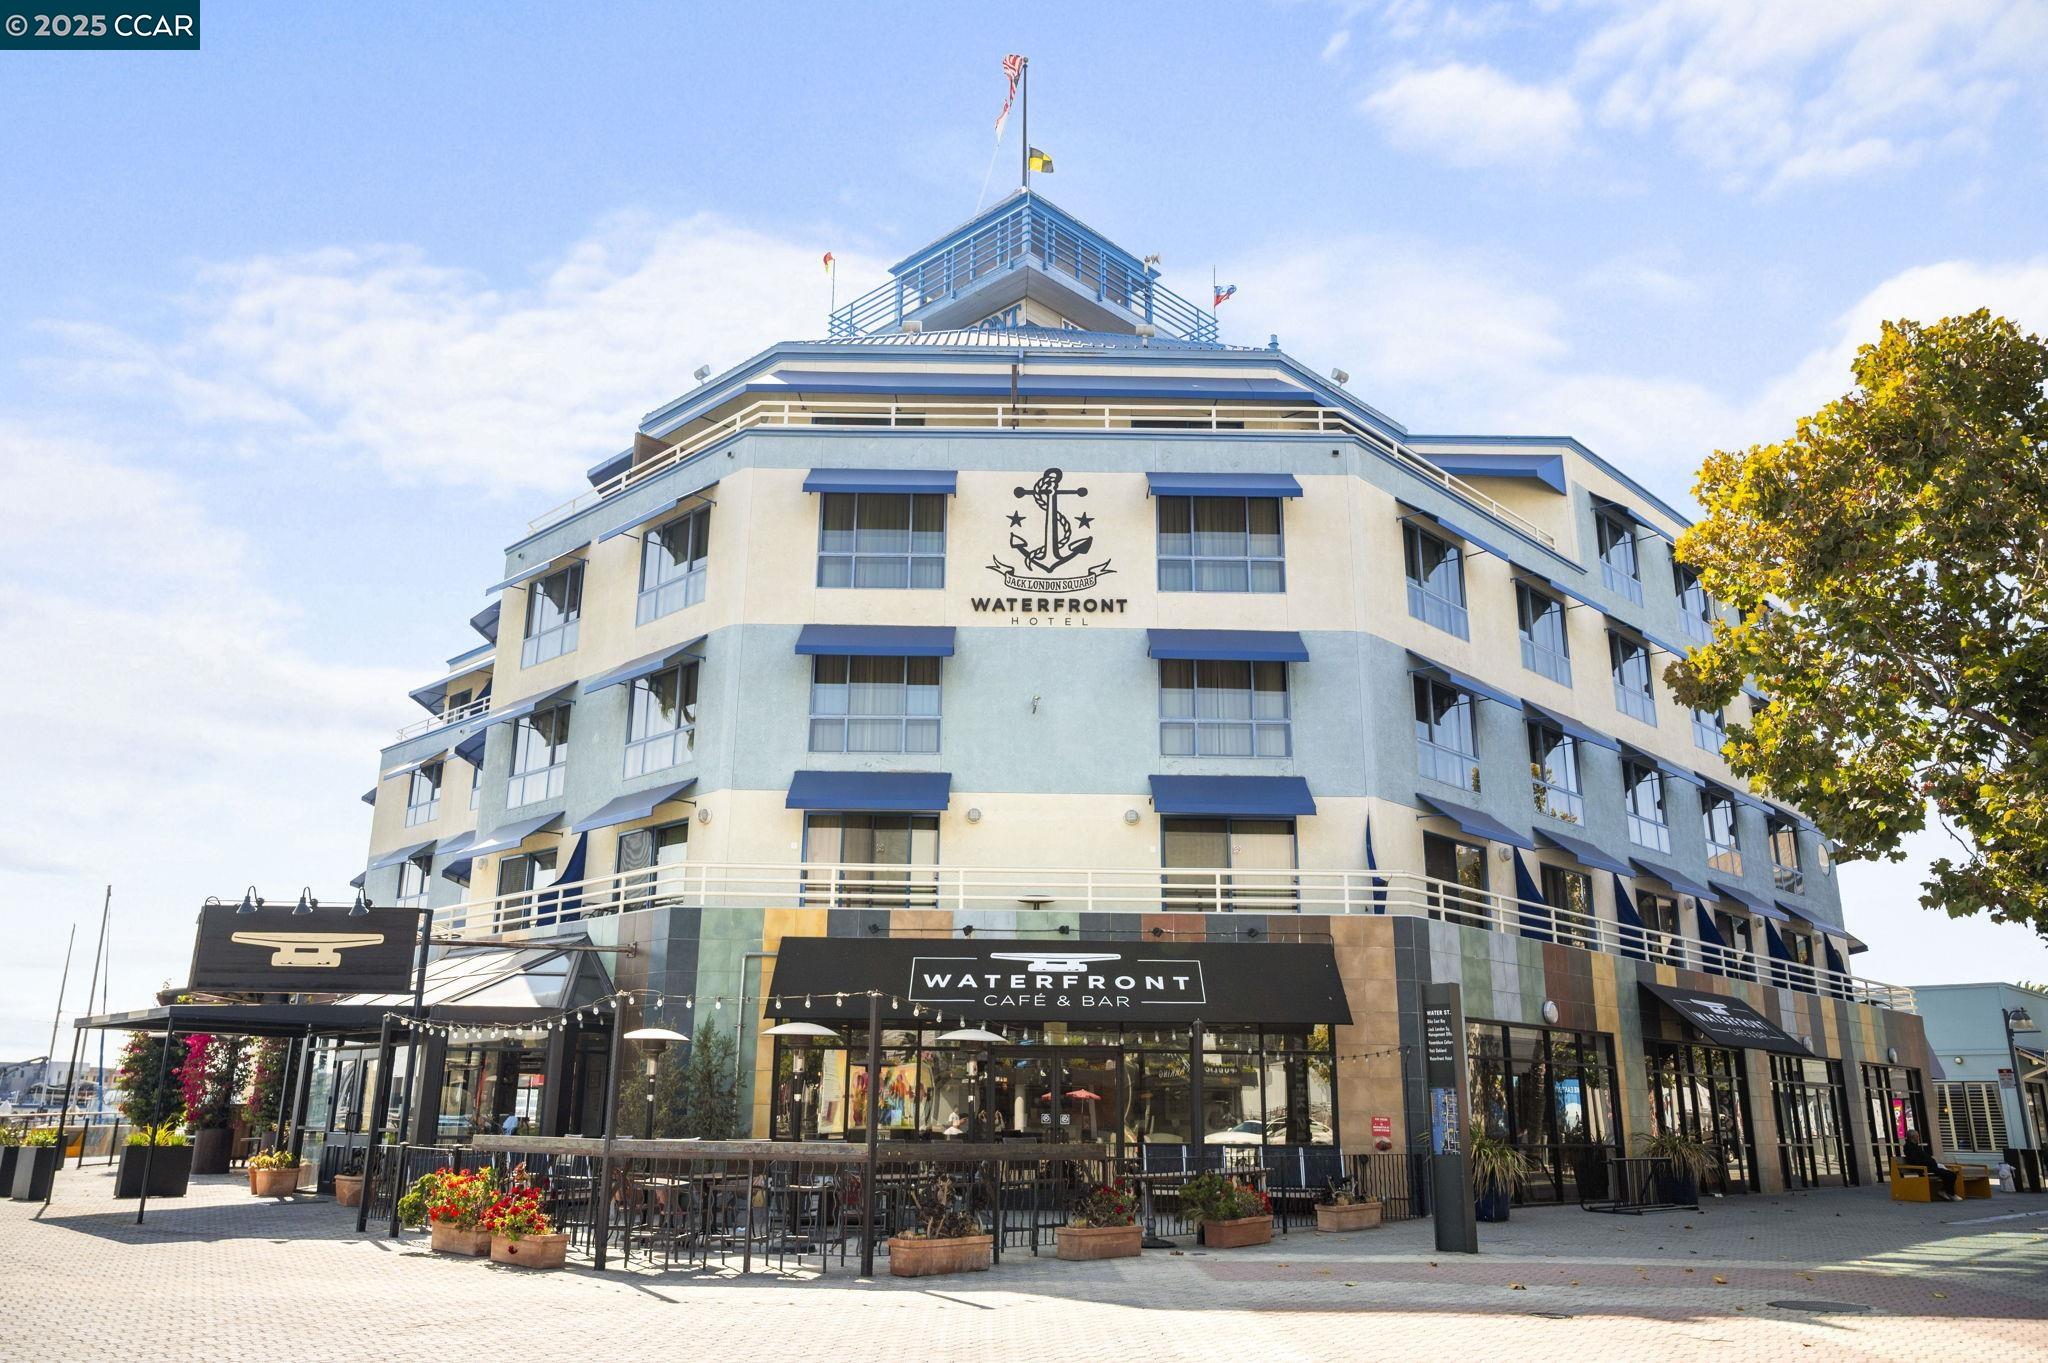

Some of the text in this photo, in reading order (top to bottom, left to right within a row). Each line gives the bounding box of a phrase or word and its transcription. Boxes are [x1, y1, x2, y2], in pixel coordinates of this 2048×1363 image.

[1006, 576, 1095, 590] JACK LONDON SQUARE
[971, 598, 1128, 613] WATERFRONT
[1011, 617, 1088, 626] HOTEL
[923, 974, 1190, 990] WATERFRONT
[983, 993, 1130, 1008] CAFÉ & BAR
